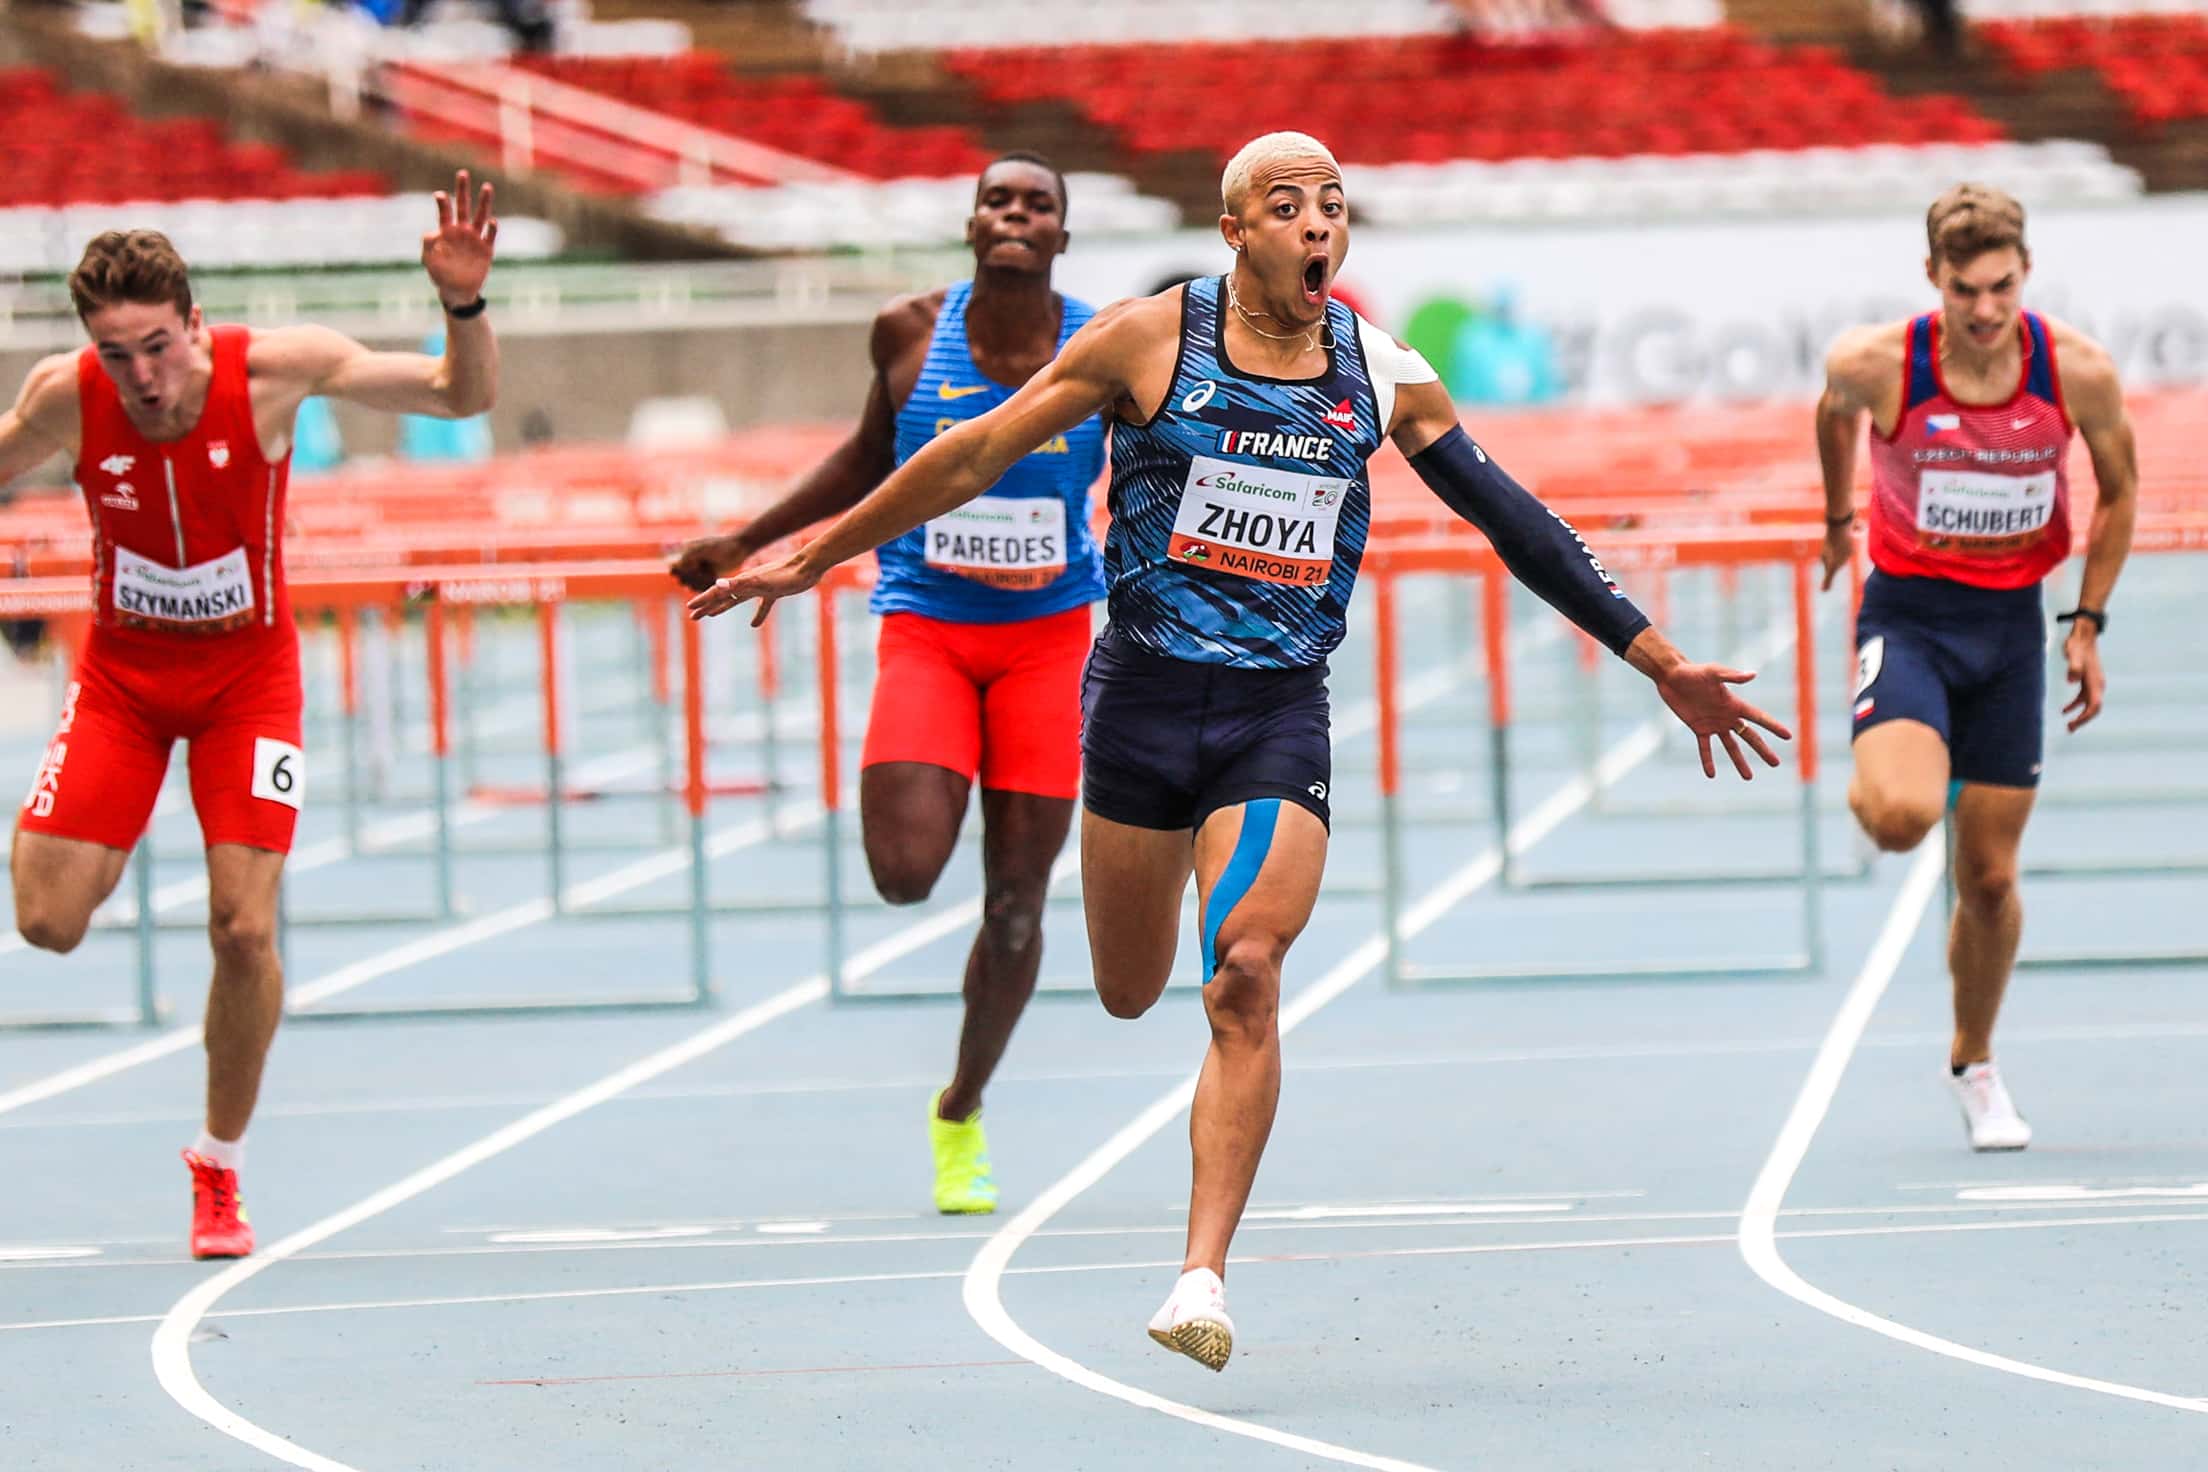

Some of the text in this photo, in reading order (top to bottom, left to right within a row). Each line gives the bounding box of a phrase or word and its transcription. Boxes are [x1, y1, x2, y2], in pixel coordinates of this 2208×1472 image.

[1327, 409, 1353, 424] MAIF
[1237, 431, 1333, 462] FRANCE
[1215, 475, 1297, 502] Safaricom
[1198, 502, 1316, 554] ZHOYA
[1926, 503, 2045, 534] SCHUBERT
[935, 532, 1056, 564] PAREDES
[1219, 552, 1323, 582] NAIROBI 21
[119, 584, 245, 620] SZYMAŃSKI
[272, 754, 293, 793] 6
